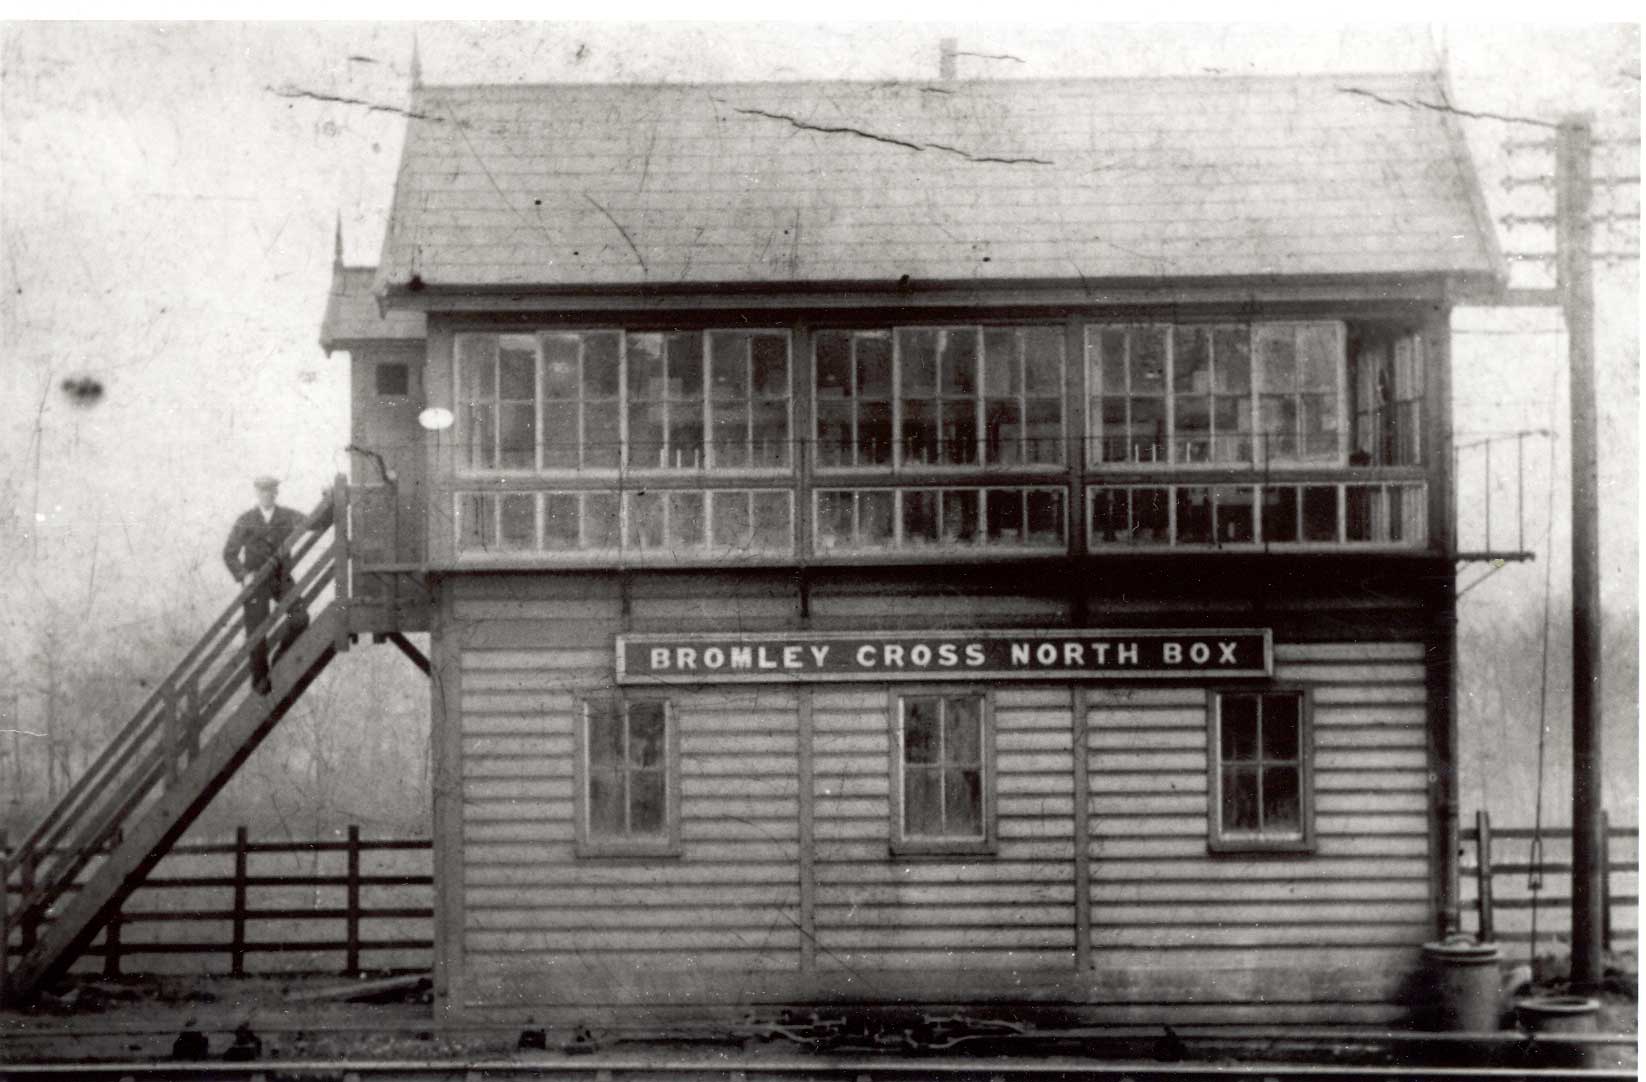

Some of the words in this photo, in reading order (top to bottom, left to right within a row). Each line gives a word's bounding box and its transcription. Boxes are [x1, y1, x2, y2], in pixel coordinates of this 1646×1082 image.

[650, 646, 831, 670] BROMLEY
[856, 644, 986, 667] CROSS
[1010, 643, 1140, 666] NORTH
[1163, 641, 1239, 664] BOX
